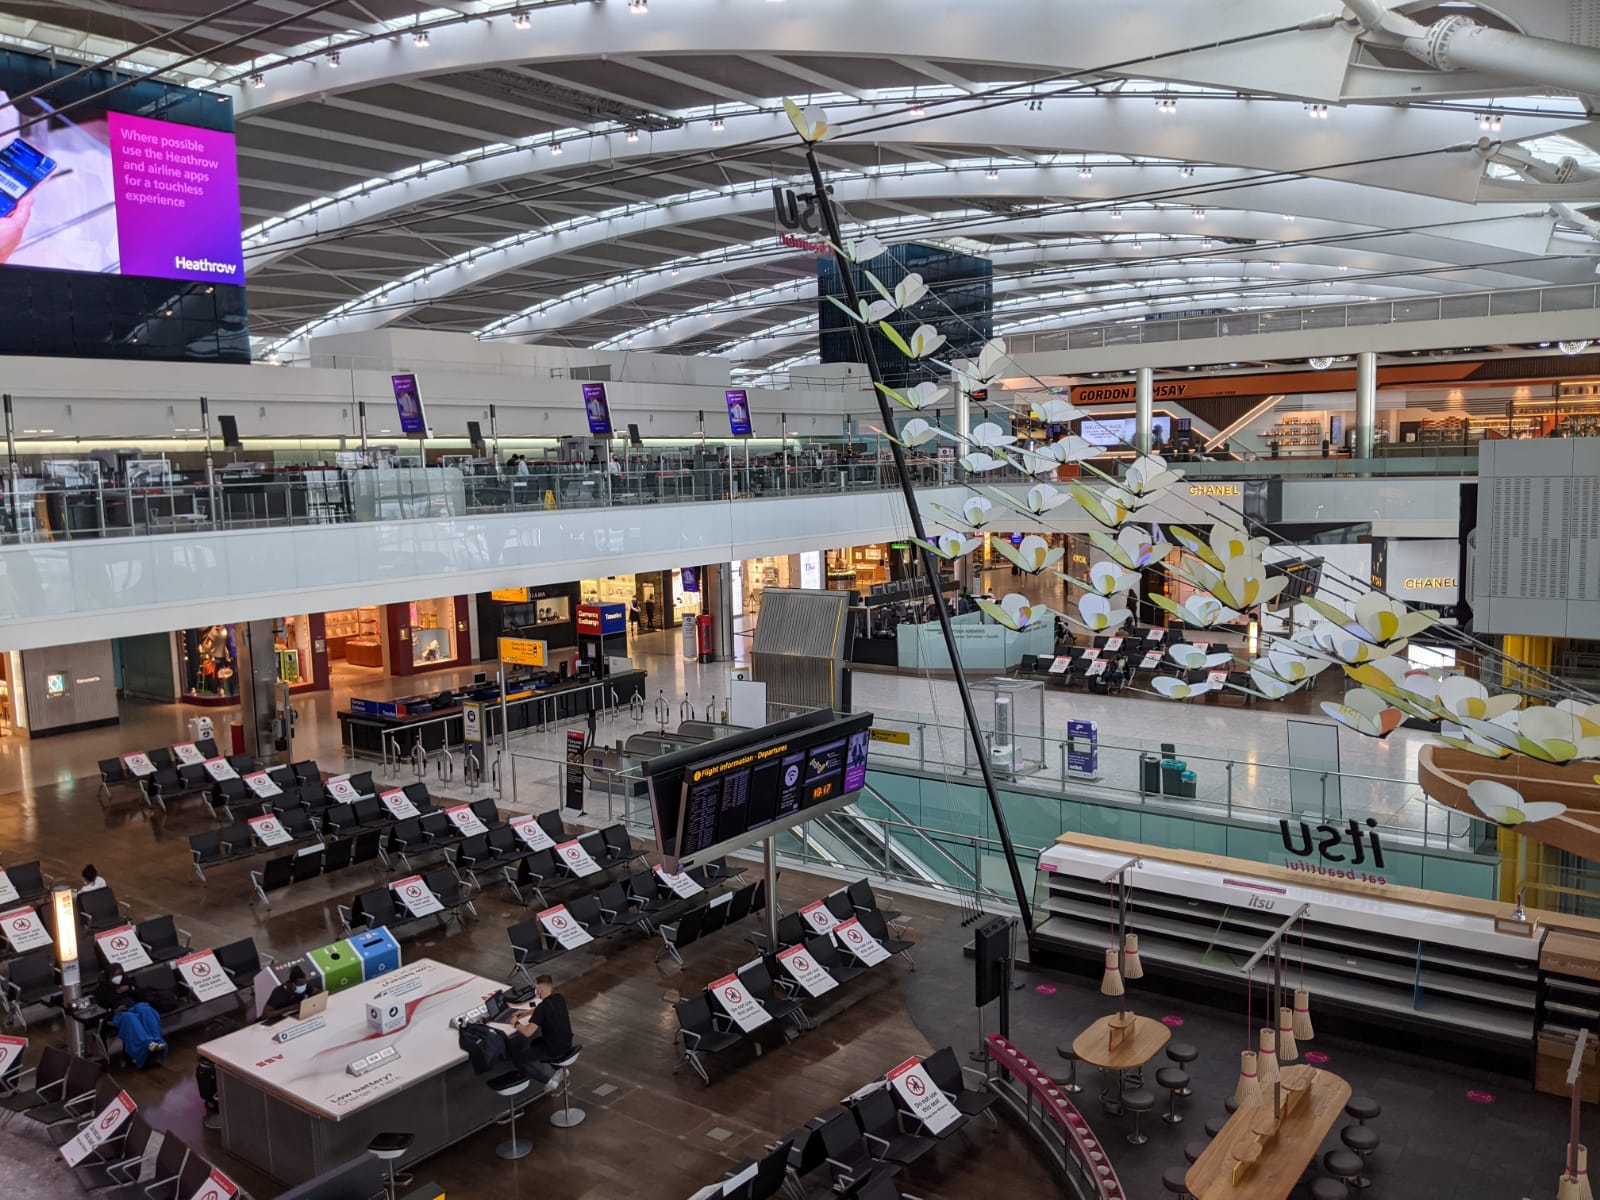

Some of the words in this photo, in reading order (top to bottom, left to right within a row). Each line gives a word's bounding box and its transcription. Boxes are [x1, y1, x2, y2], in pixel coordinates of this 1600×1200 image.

[120, 128, 158, 144] Where
[161, 137, 204, 152] possible
[122, 146, 142, 155] use
[144, 147, 163, 160] the
[166, 151, 218, 169] Heathrow
[123, 161, 145, 172] and
[148, 163, 182, 178] airline
[184, 170, 209, 183] apps
[124, 174, 141, 186] for
[144, 180, 151, 188] a
[154, 180, 203, 195] touchless
[126, 192, 185, 208] experience
[175, 256, 236, 274] Heathrow
[1079, 388, 1131, 401] GORDON
[1133, 385, 1186, 399] MSAY
[1189, 484, 1241, 496] CHANEL
[1404, 577, 1459, 590] CHANEL
[701, 765, 719, 778] Flight
[758, 744, 788, 759] Departures
[1248, 894, 1275, 910] itsu
[330, 1092, 352, 1104] Low
[352, 1072, 393, 1093] battery?
[922, 1104, 932, 1113] this
[931, 1098, 941, 1107] seat
